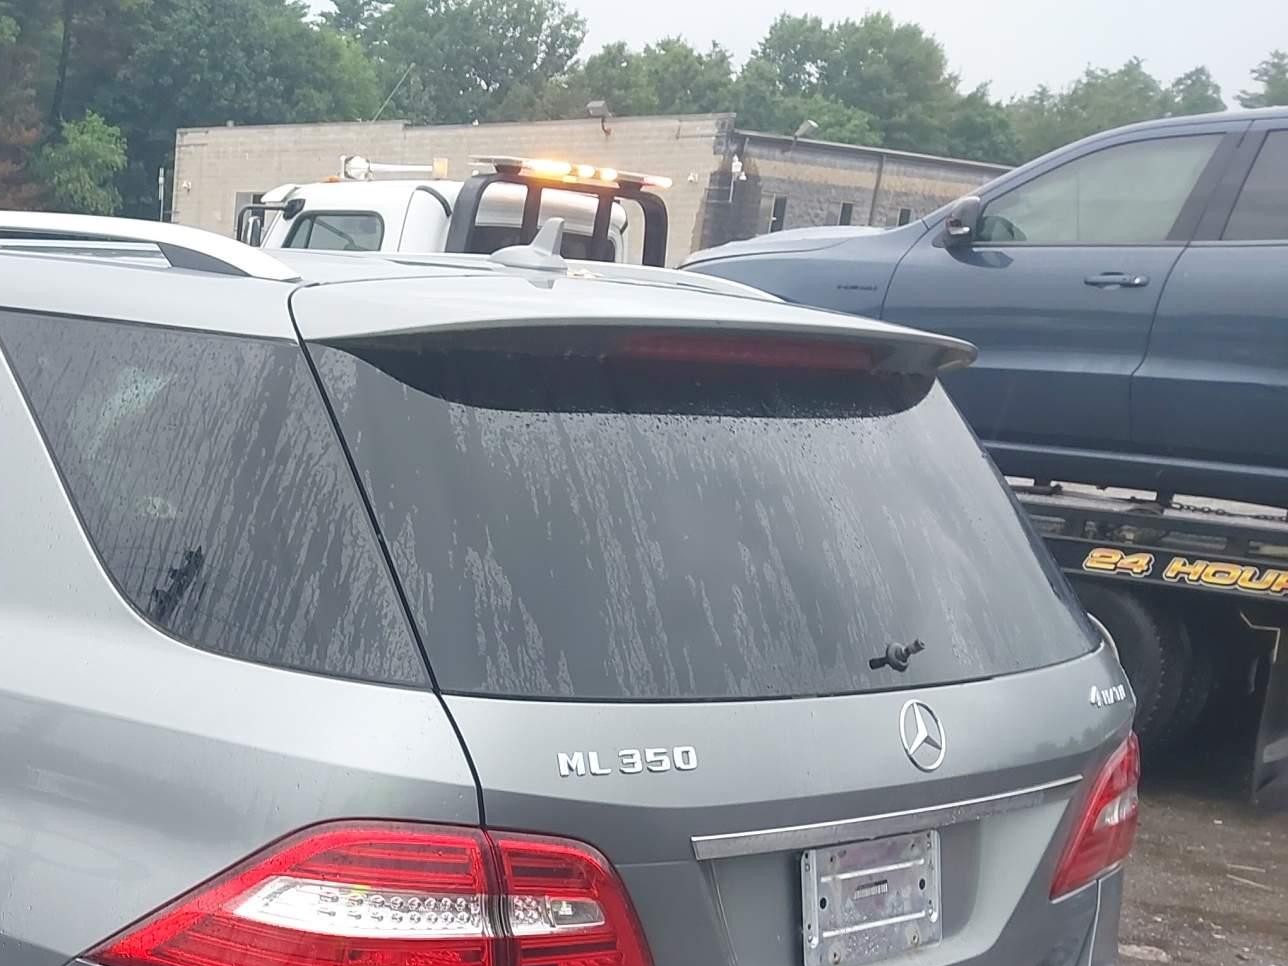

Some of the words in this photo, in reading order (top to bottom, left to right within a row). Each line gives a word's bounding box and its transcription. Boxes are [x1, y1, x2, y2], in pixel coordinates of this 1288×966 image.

[1084, 548, 1154, 576] 24
[557, 751, 612, 777] ML
[618, 746, 698, 774] 350
